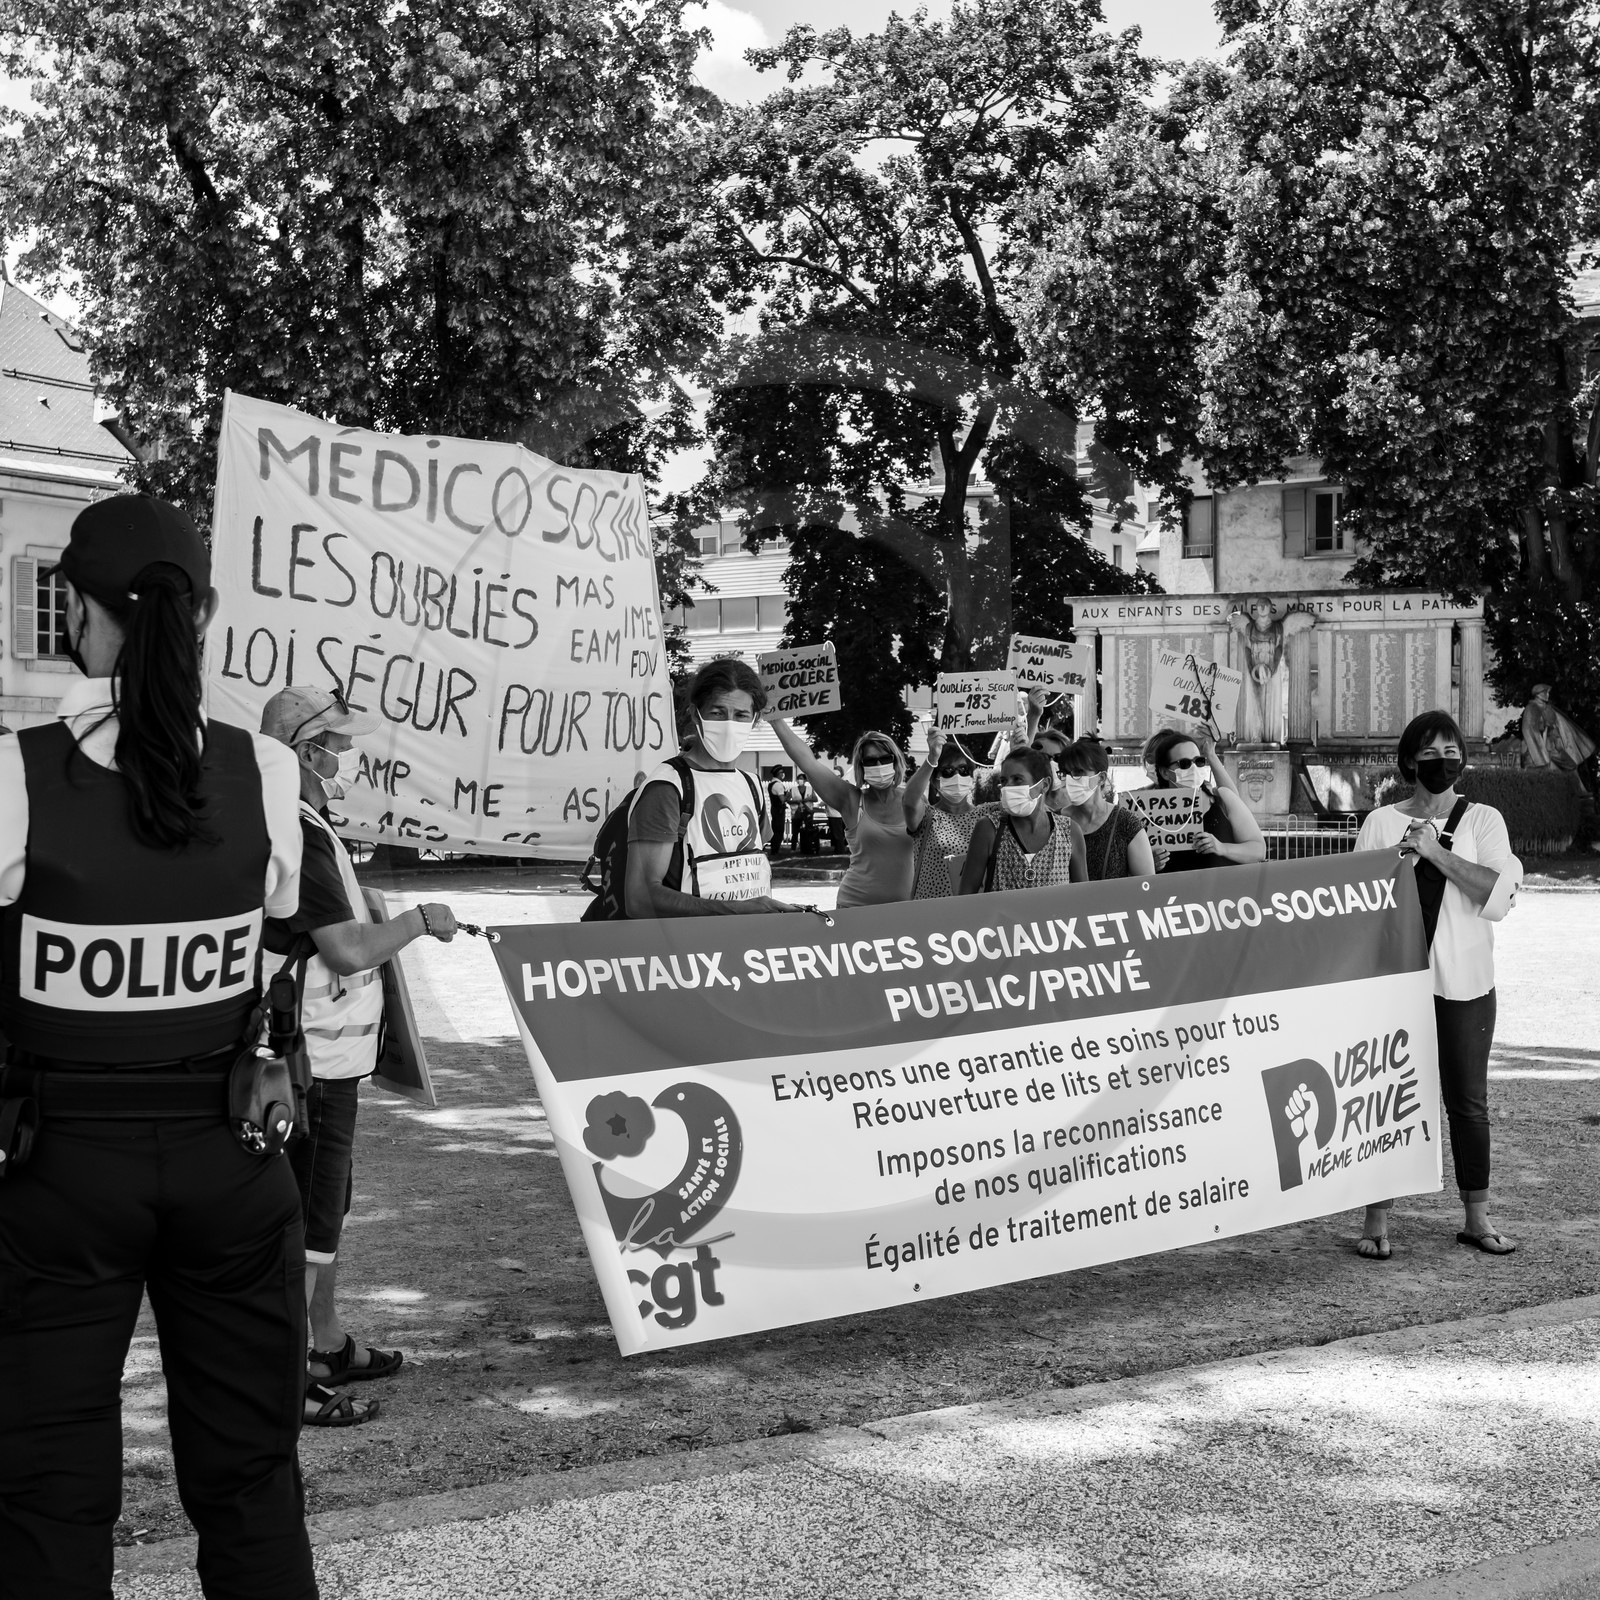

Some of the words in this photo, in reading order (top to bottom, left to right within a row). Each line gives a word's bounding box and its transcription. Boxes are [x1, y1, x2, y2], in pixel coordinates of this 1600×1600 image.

[252, 515, 357, 607] LES
[370, 551, 538, 649] OUBLIÉS
[556, 574, 614, 609] MAS
[624, 605, 656, 640] IME
[1081, 607, 1109, 619] AUX
[1118, 605, 1182, 618] ENFANTS
[1193, 604, 1221, 616] DES
[1232, 603, 1277, 614] ALPS
[1286, 601, 1333, 613] MORTS
[1343, 600, 1383, 612] POUR
[1393, 599, 1412, 611] LA
[571, 628, 620, 667] EAM
[631, 649, 658, 679] FDV
[1027, 655, 1044, 666] AU
[316, 634, 477, 737] SÉGUR
[499, 684, 590, 757] POUR
[602, 690, 663, 751] TOUS
[778, 668, 836, 689] COLÈRE
[778, 689, 831, 711] GRÈVE
[1149, 796, 1177, 810] PAS
[1182, 796, 1199, 808] DE
[1148, 830, 1195, 846] GIQUE
[521, 951, 741, 1002] HOPITAUX,
[743, 937, 924, 984] SERVICES
[927, 917, 1087, 966] SOCIAUX
[1087, 911, 1129, 947] ET
[1136, 878, 1397, 941] MÉDICO-SOCIAUX
[34, 924, 251, 998] POLICE
[884, 949, 1151, 1022] PUBLIC/PRIVÉ
[771, 1067, 896, 1101] Exigeons
[902, 1061, 950, 1084] une
[958, 1040, 1064, 1082] garantie
[1071, 1036, 1100, 1060] de
[1106, 1027, 1169, 1055] soins
[1175, 1020, 1226, 1051] pour
[1232, 1012, 1280, 1037] tous
[853, 1087, 1019, 1129] Réouverture
[1026, 1078, 1055, 1103] de
[1061, 1071, 1101, 1097] lits
[1107, 1064, 1132, 1091] et
[1139, 1053, 1230, 1086] services
[702, 1137, 713, 1153] ET
[877, 1137, 1006, 1177] Imposons
[1014, 1129, 1035, 1155] la
[1043, 1102, 1222, 1150] reconnaissance
[680, 1179, 720, 1224] ACTION
[714, 1116, 729, 1177] SOCIALE
[935, 1177, 966, 1205] de
[975, 1172, 1019, 1199] nos
[1027, 1143, 1187, 1195] qualifications
[1308, 1147, 1353, 1180] MÊME
[865, 1225, 960, 1272] Égalité
[968, 1222, 999, 1250] de
[1007, 1194, 1138, 1243] traitement
[1144, 1190, 1171, 1217] de
[1179, 1177, 1249, 1210] salaire
